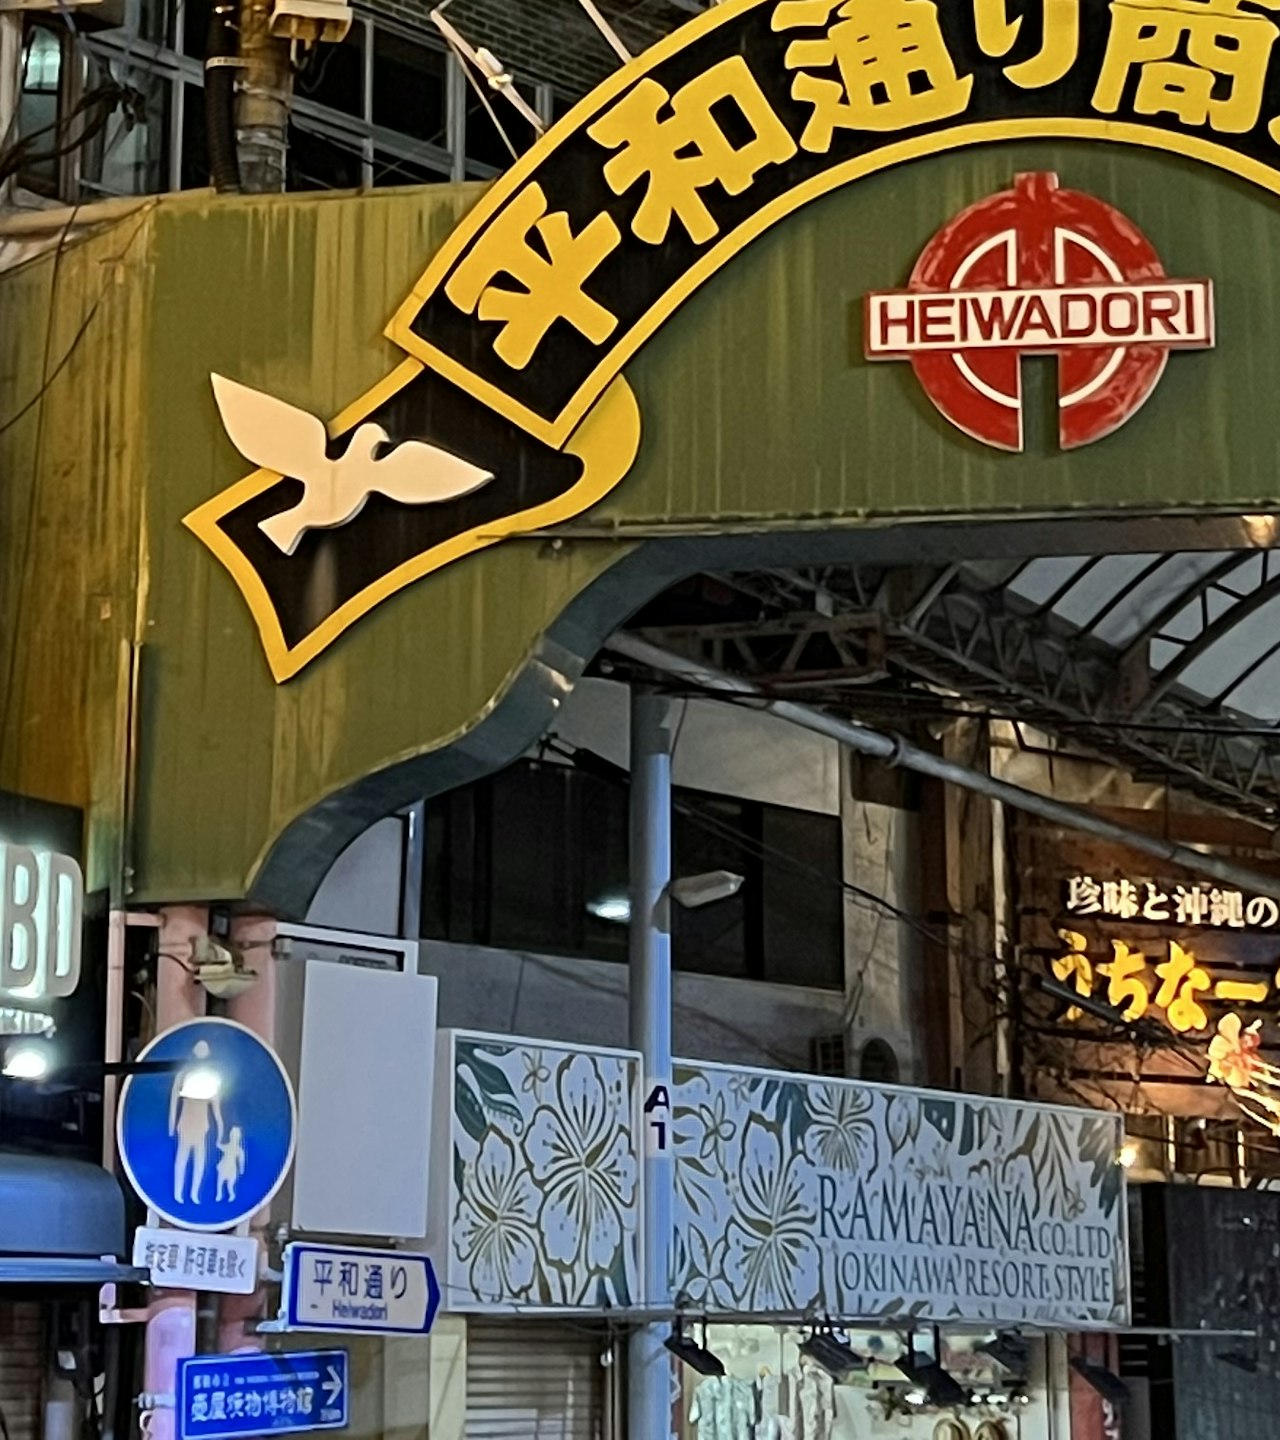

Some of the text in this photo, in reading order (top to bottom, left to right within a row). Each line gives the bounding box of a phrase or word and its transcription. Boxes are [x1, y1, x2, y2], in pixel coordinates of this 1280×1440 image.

[879, 289, 1196, 347] HEIWADORI
[817, 1173, 1038, 1253] RAMAYANA
[312, 1259, 408, 1300] 平和通り
[841, 1251, 1111, 1304] OKINAWA RESORT STYLE
[332, 1299, 388, 1322] Heiwadori
